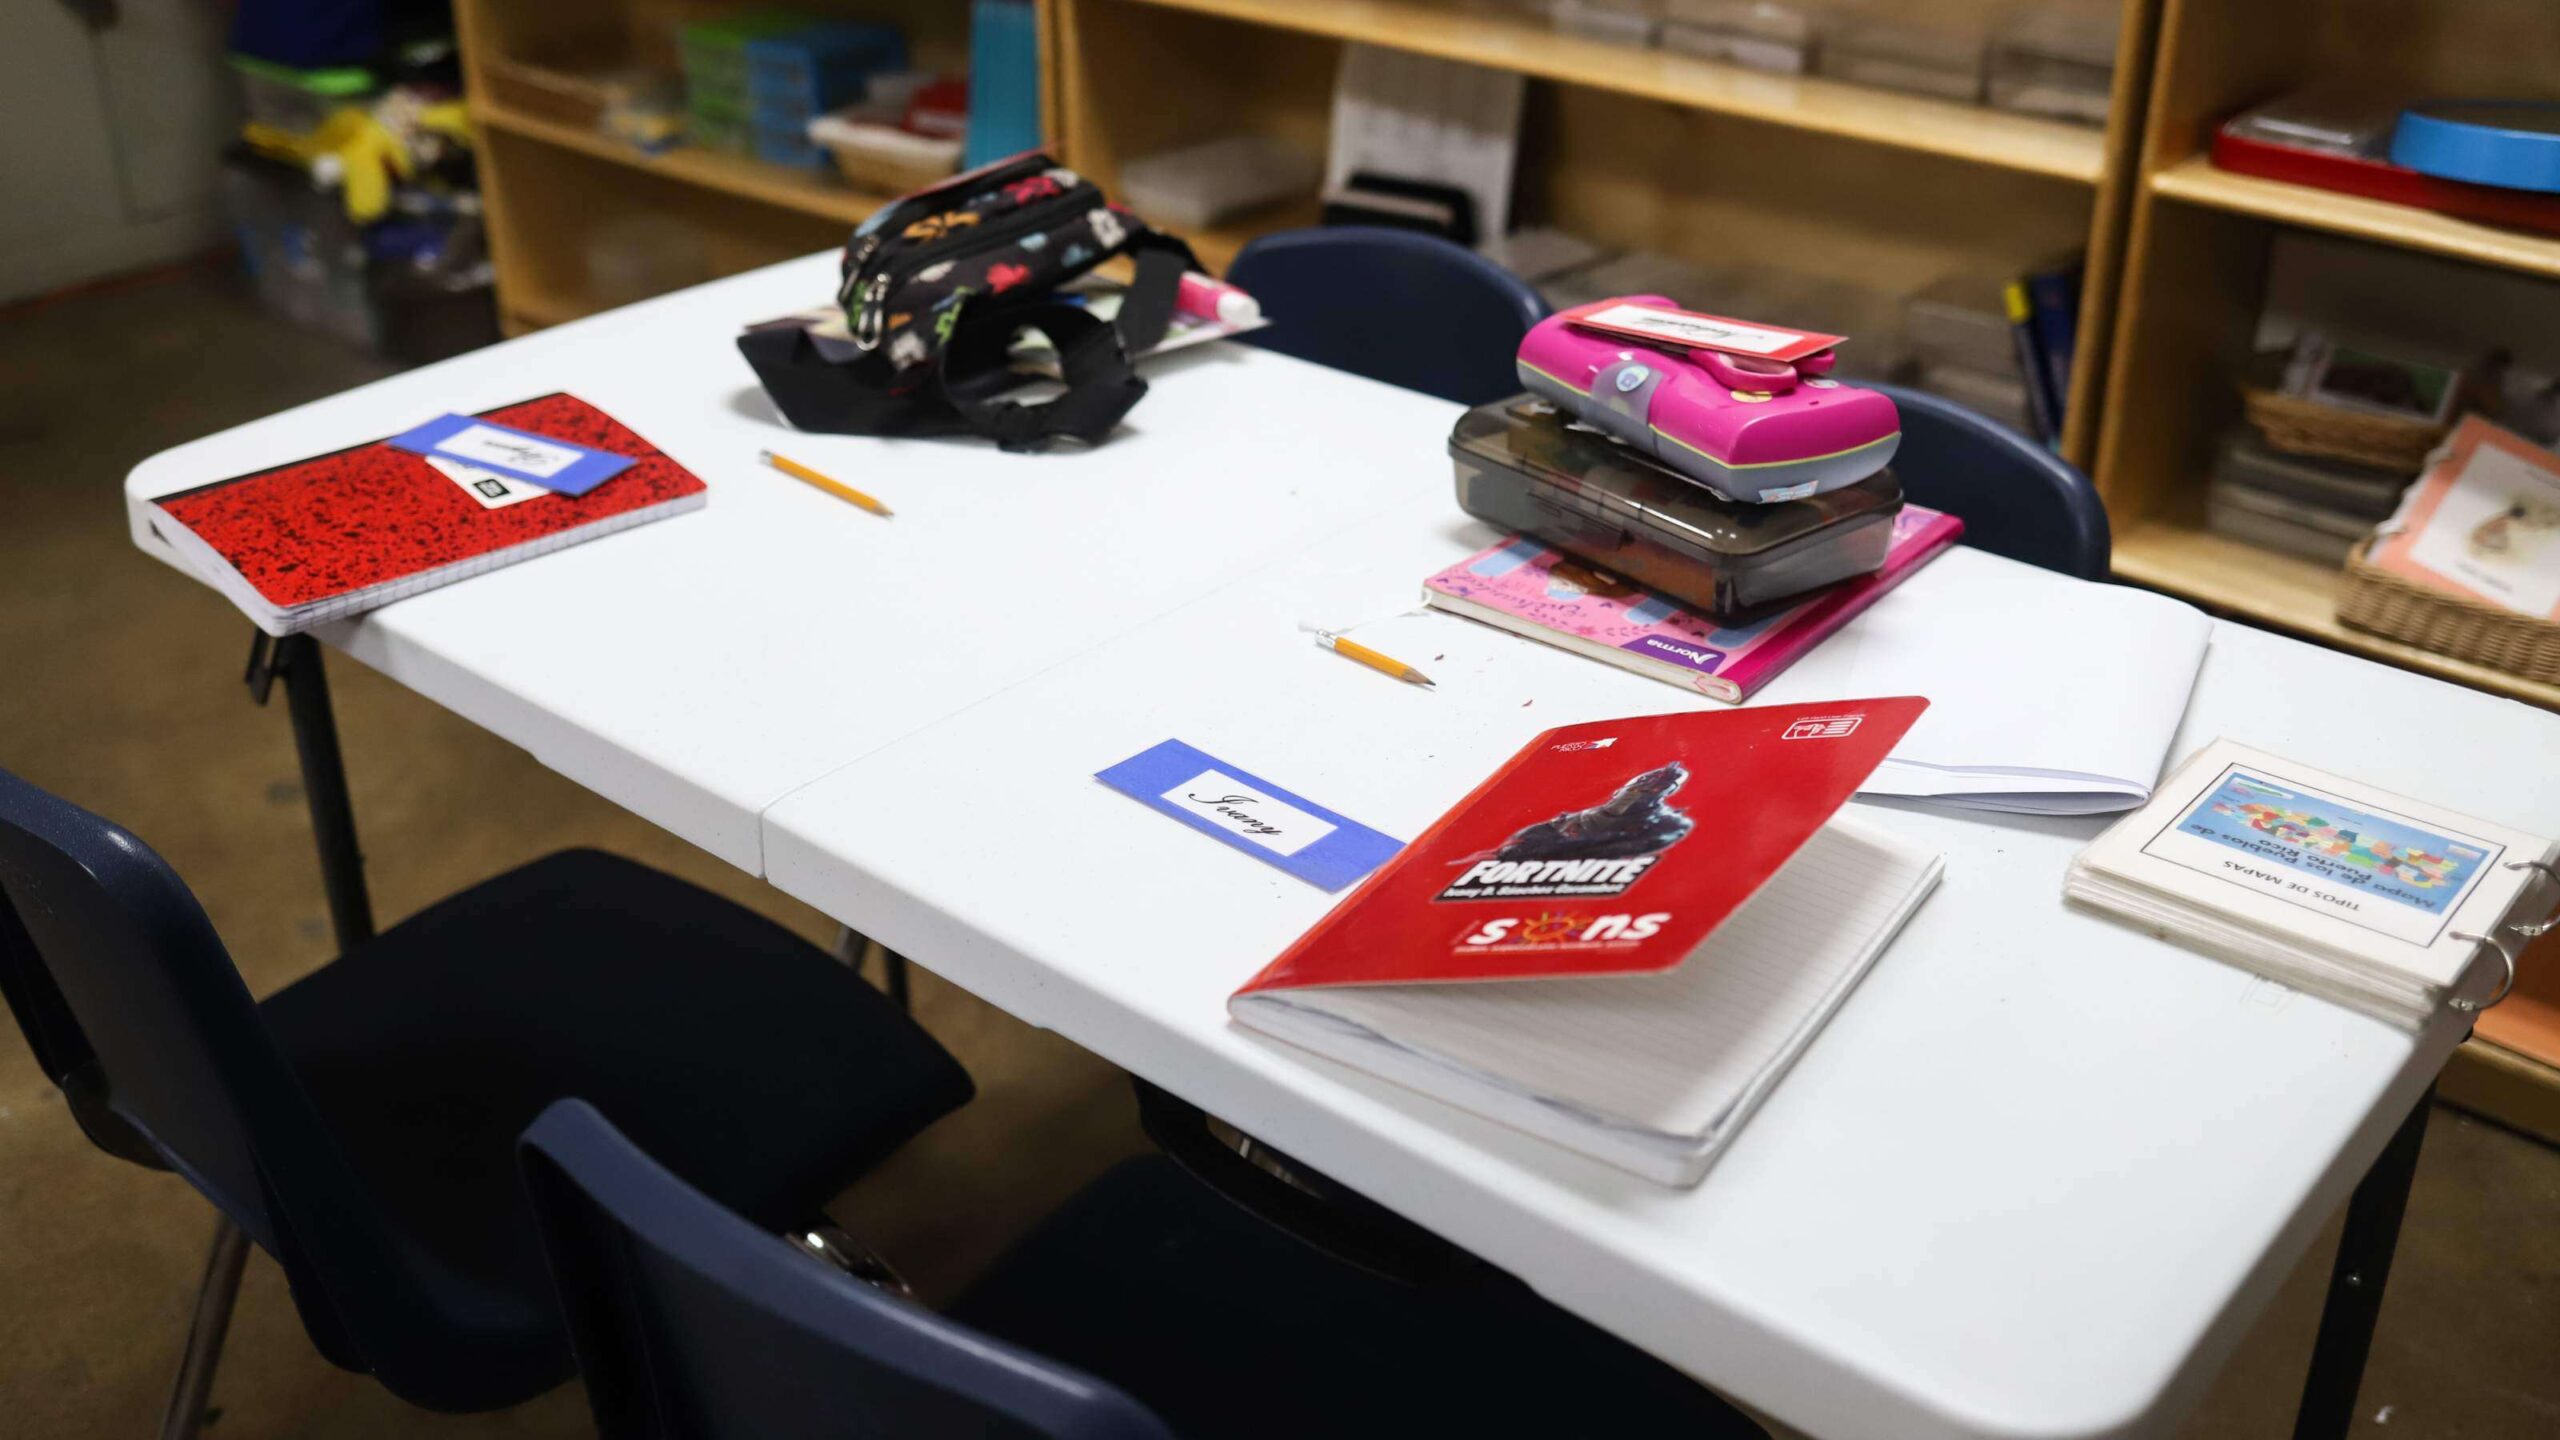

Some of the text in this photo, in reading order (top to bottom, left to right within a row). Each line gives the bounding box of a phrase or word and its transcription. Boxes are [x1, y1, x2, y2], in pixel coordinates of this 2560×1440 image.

[1646, 637, 1717, 666] Norma
[1188, 793, 1283, 836] Ivany
[1453, 855, 1657, 887] FORTNITE
[2190, 823, 2437, 909] Mapa de los Pueblos de
[2259, 839, 2373, 881] Puerto Rico
[2223, 860, 2360, 912] TIPOS DE MAPAS
